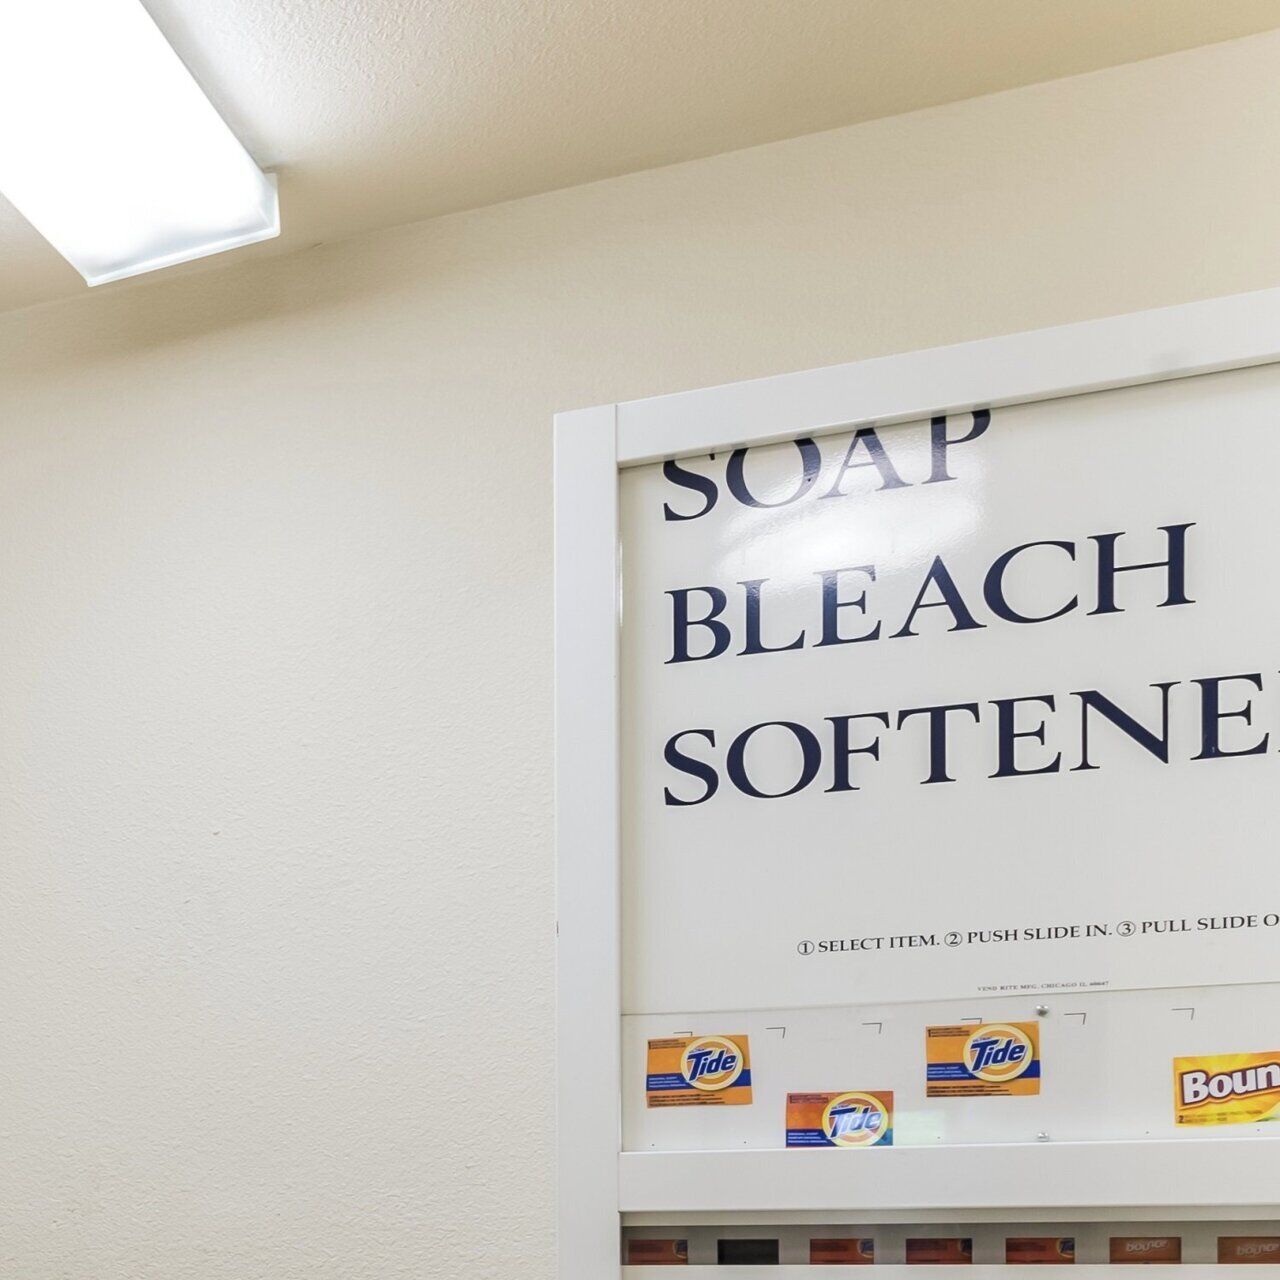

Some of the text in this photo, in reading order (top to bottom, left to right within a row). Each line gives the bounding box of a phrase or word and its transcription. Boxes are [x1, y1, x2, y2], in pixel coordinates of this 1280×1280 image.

[663, 408, 992, 522] SOAP
[664, 522, 1197, 665] BLEACH
[663, 669, 1280, 807] SOFTENE
[818, 937, 884, 953] SELECT
[890, 934, 940, 949] ITEM.
[967, 929, 1018, 944] PUSH
[1023, 925, 1081, 941] SLIDE
[1086, 924, 1113, 937] IN.
[1141, 919, 1191, 934] PULL
[1196, 914, 1258, 931] SLIDE
[686, 1050, 737, 1082] Tide
[970, 1038, 1026, 1072] Tide
[1181, 1063, 1280, 1105] Boun
[828, 1104, 883, 1140] Tide
